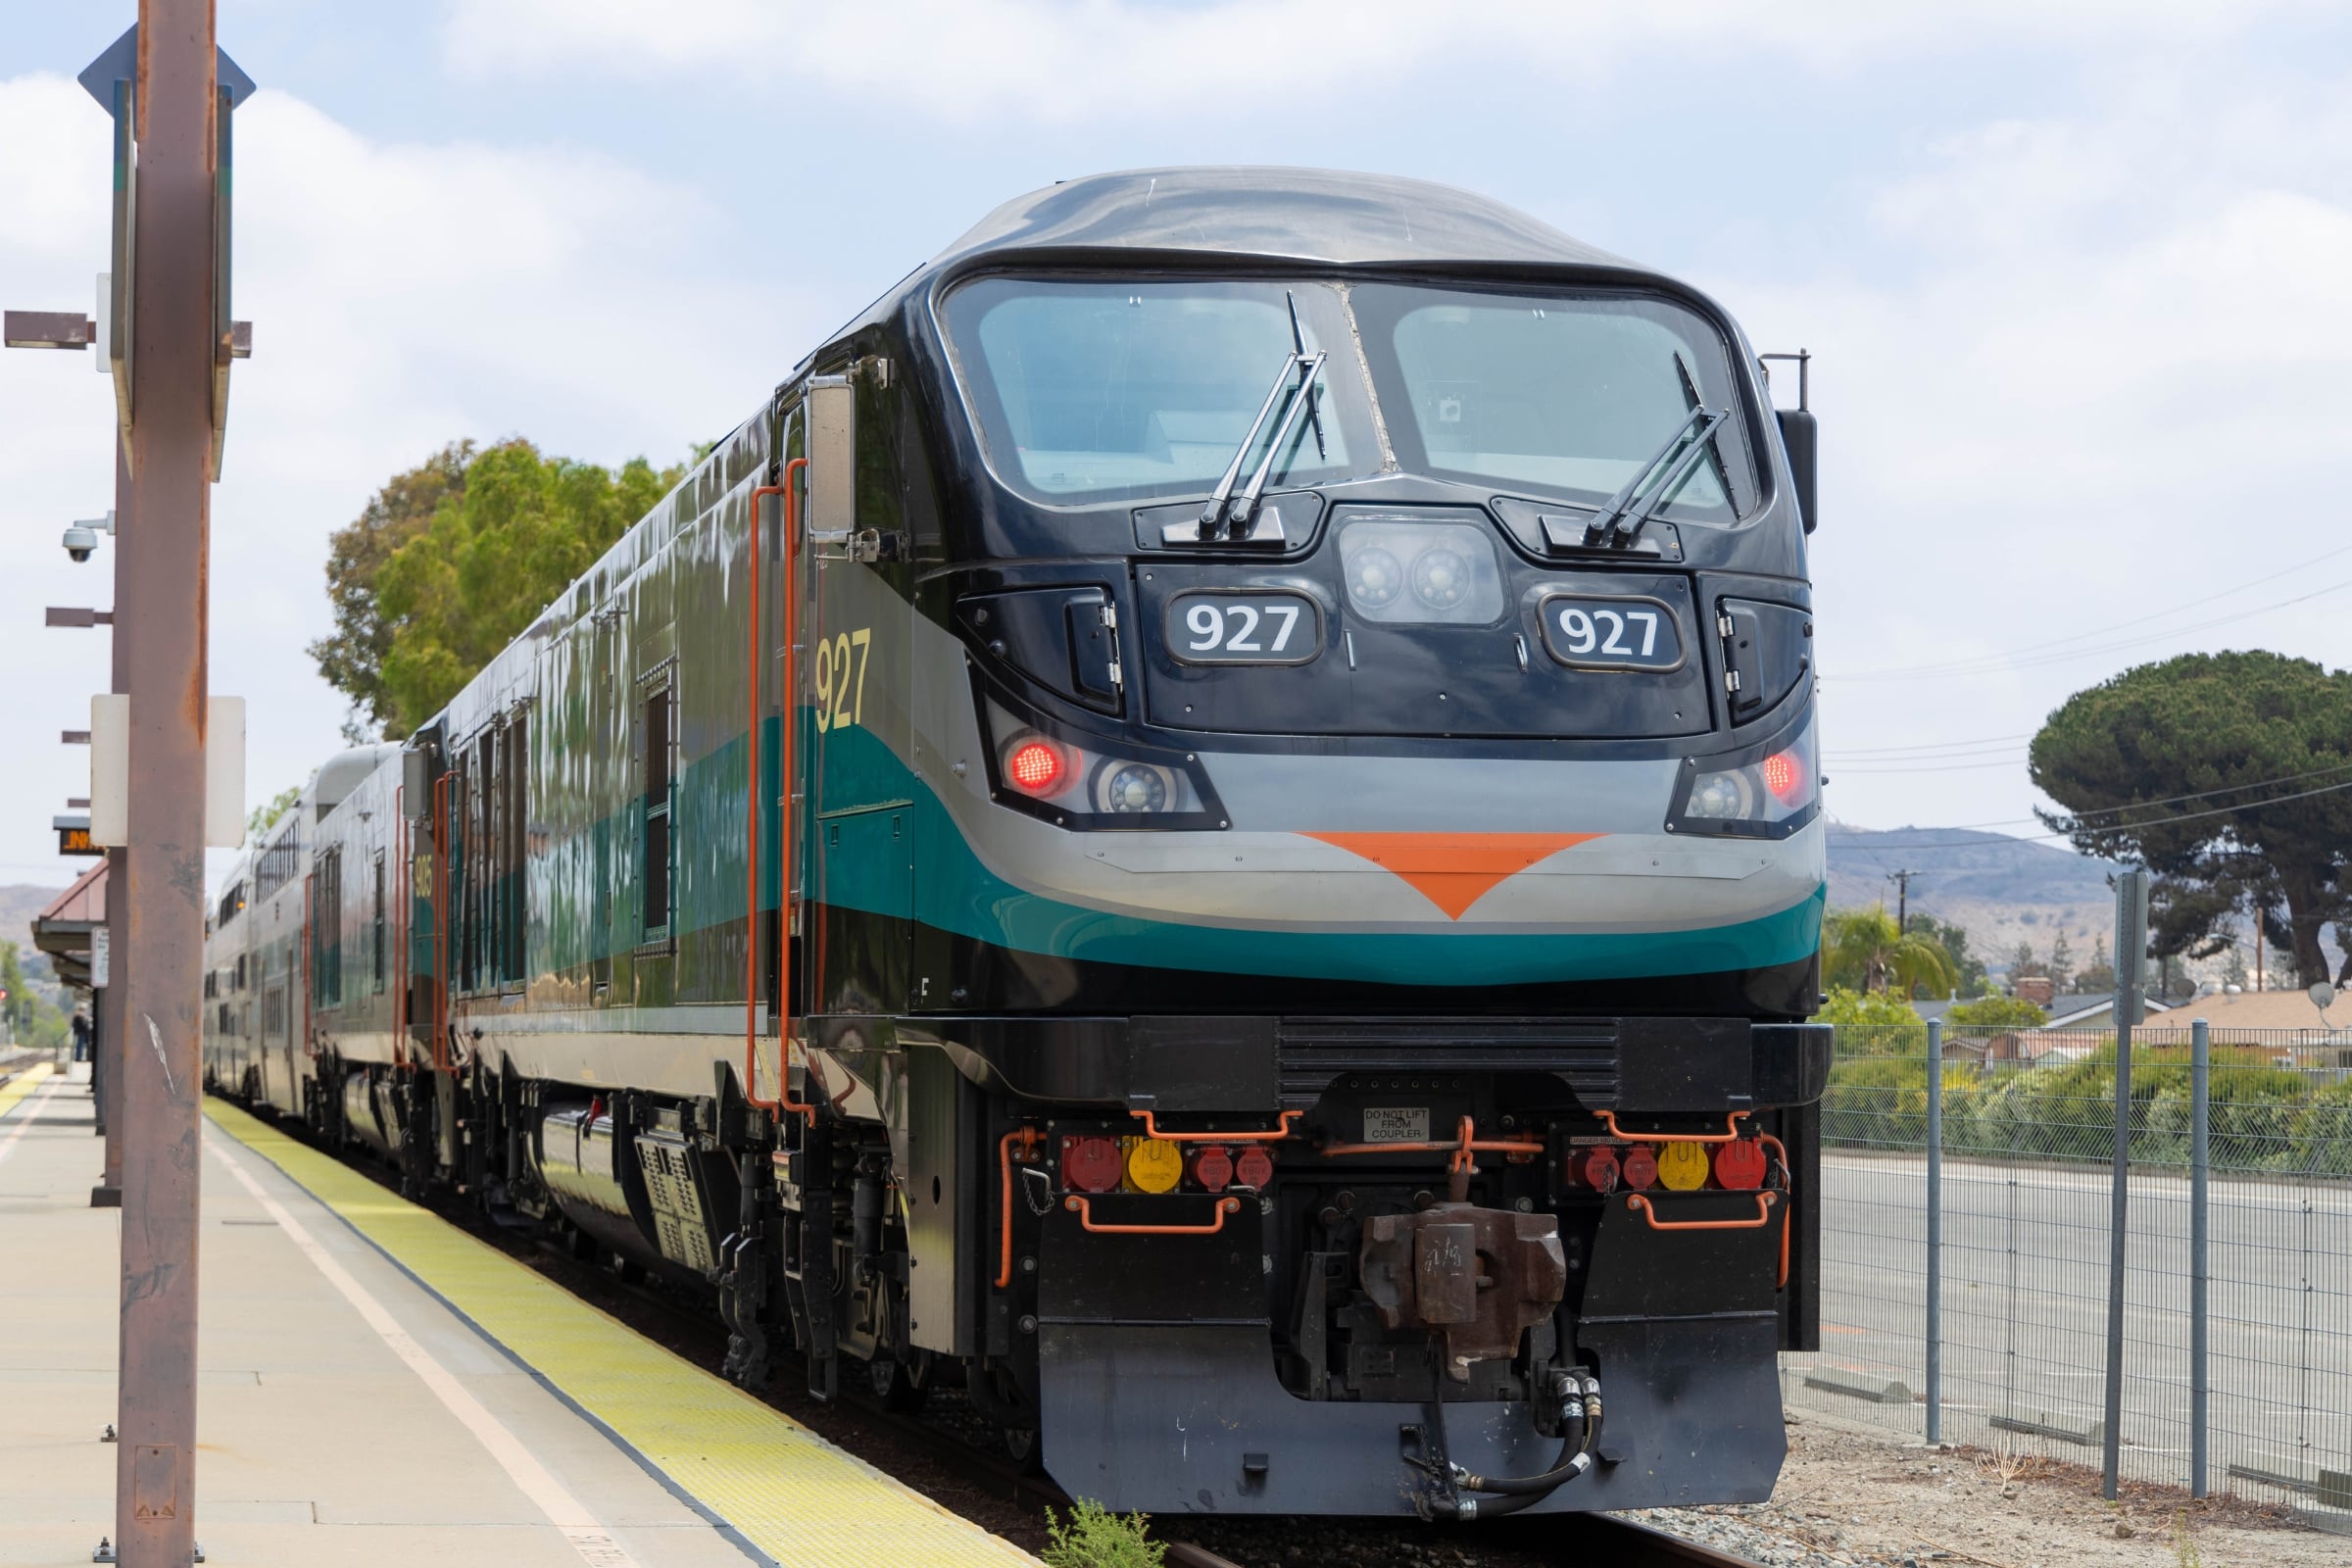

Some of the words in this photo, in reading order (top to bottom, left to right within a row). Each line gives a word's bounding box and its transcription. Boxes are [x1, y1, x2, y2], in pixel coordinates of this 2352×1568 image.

[1186, 605, 1298, 652] 927
[1559, 609, 1658, 656] 927
[815, 627, 871, 734] 927
[416, 854, 432, 899] 905
[1365, 1110, 1381, 1119] DO
[1383, 1110, 1404, 1119] NOT
[1405, 1109, 1428, 1119] LIFT
[1372, 1129, 1421, 1139] COUPLER
[1381, 1119, 1411, 1129] FROM
